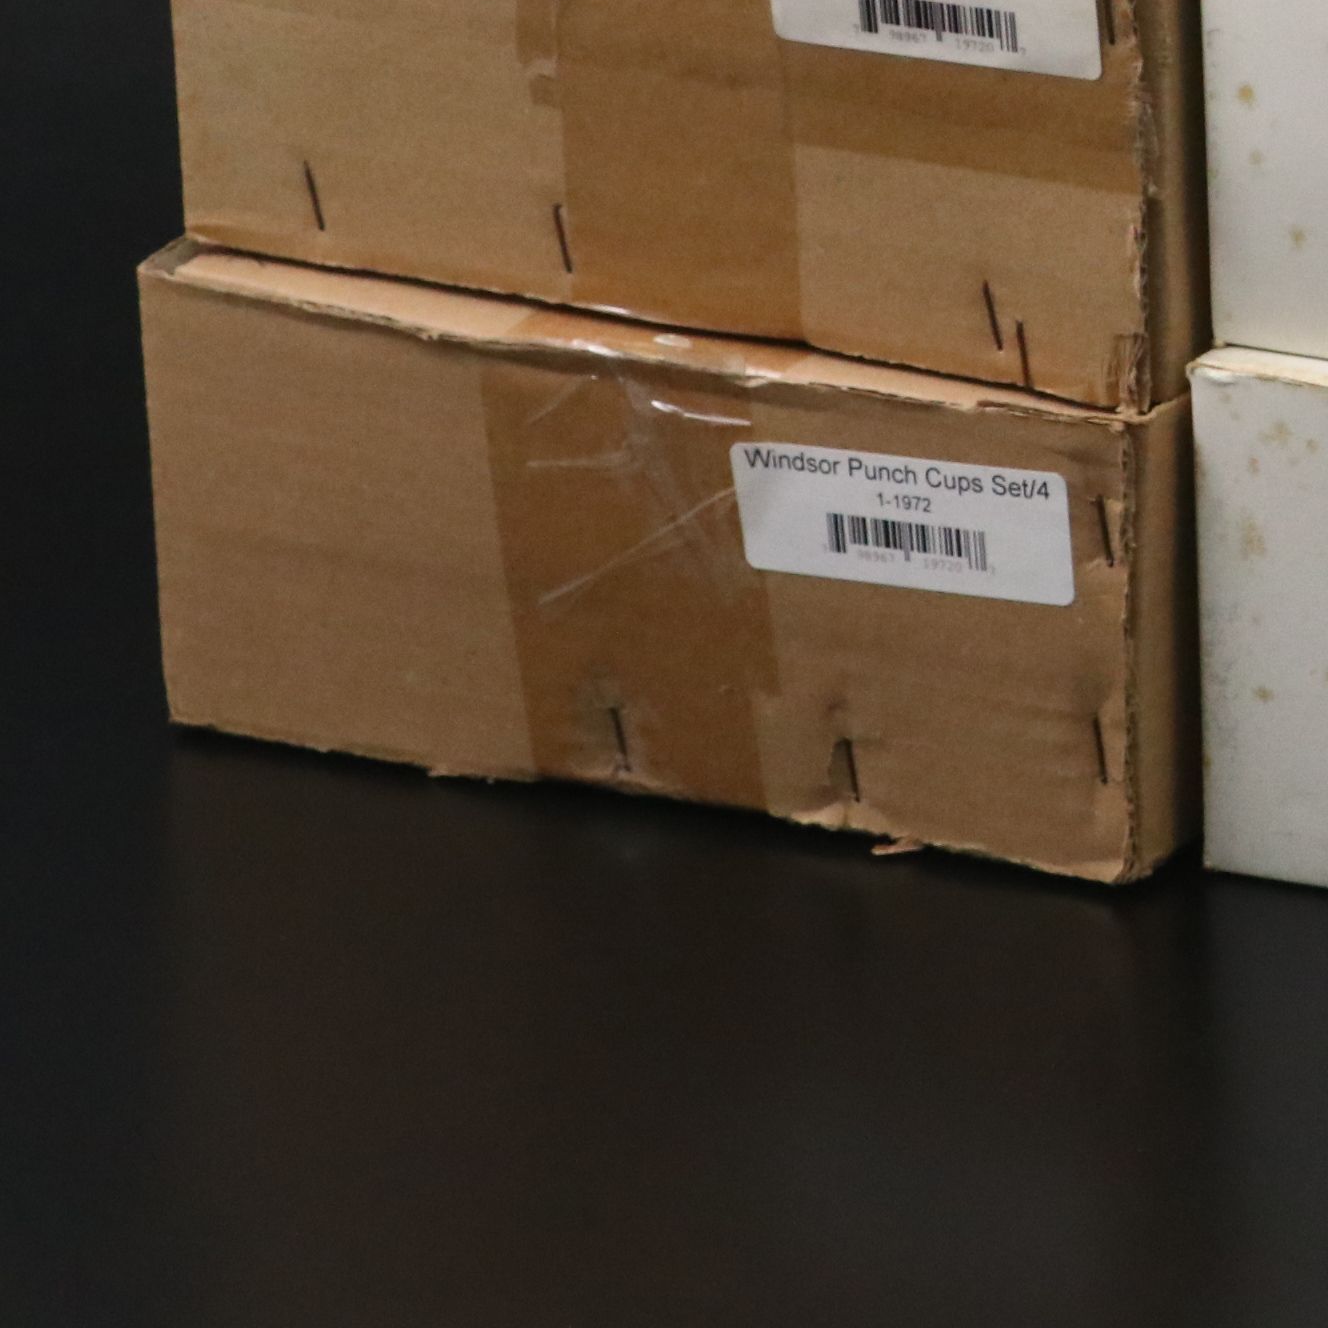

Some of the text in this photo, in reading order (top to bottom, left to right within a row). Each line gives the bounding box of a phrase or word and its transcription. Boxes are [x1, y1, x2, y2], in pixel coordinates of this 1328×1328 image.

[744, 449, 1049, 499] Windsor Punch Cups Set/4
[877, 493, 932, 513] 1-1972
